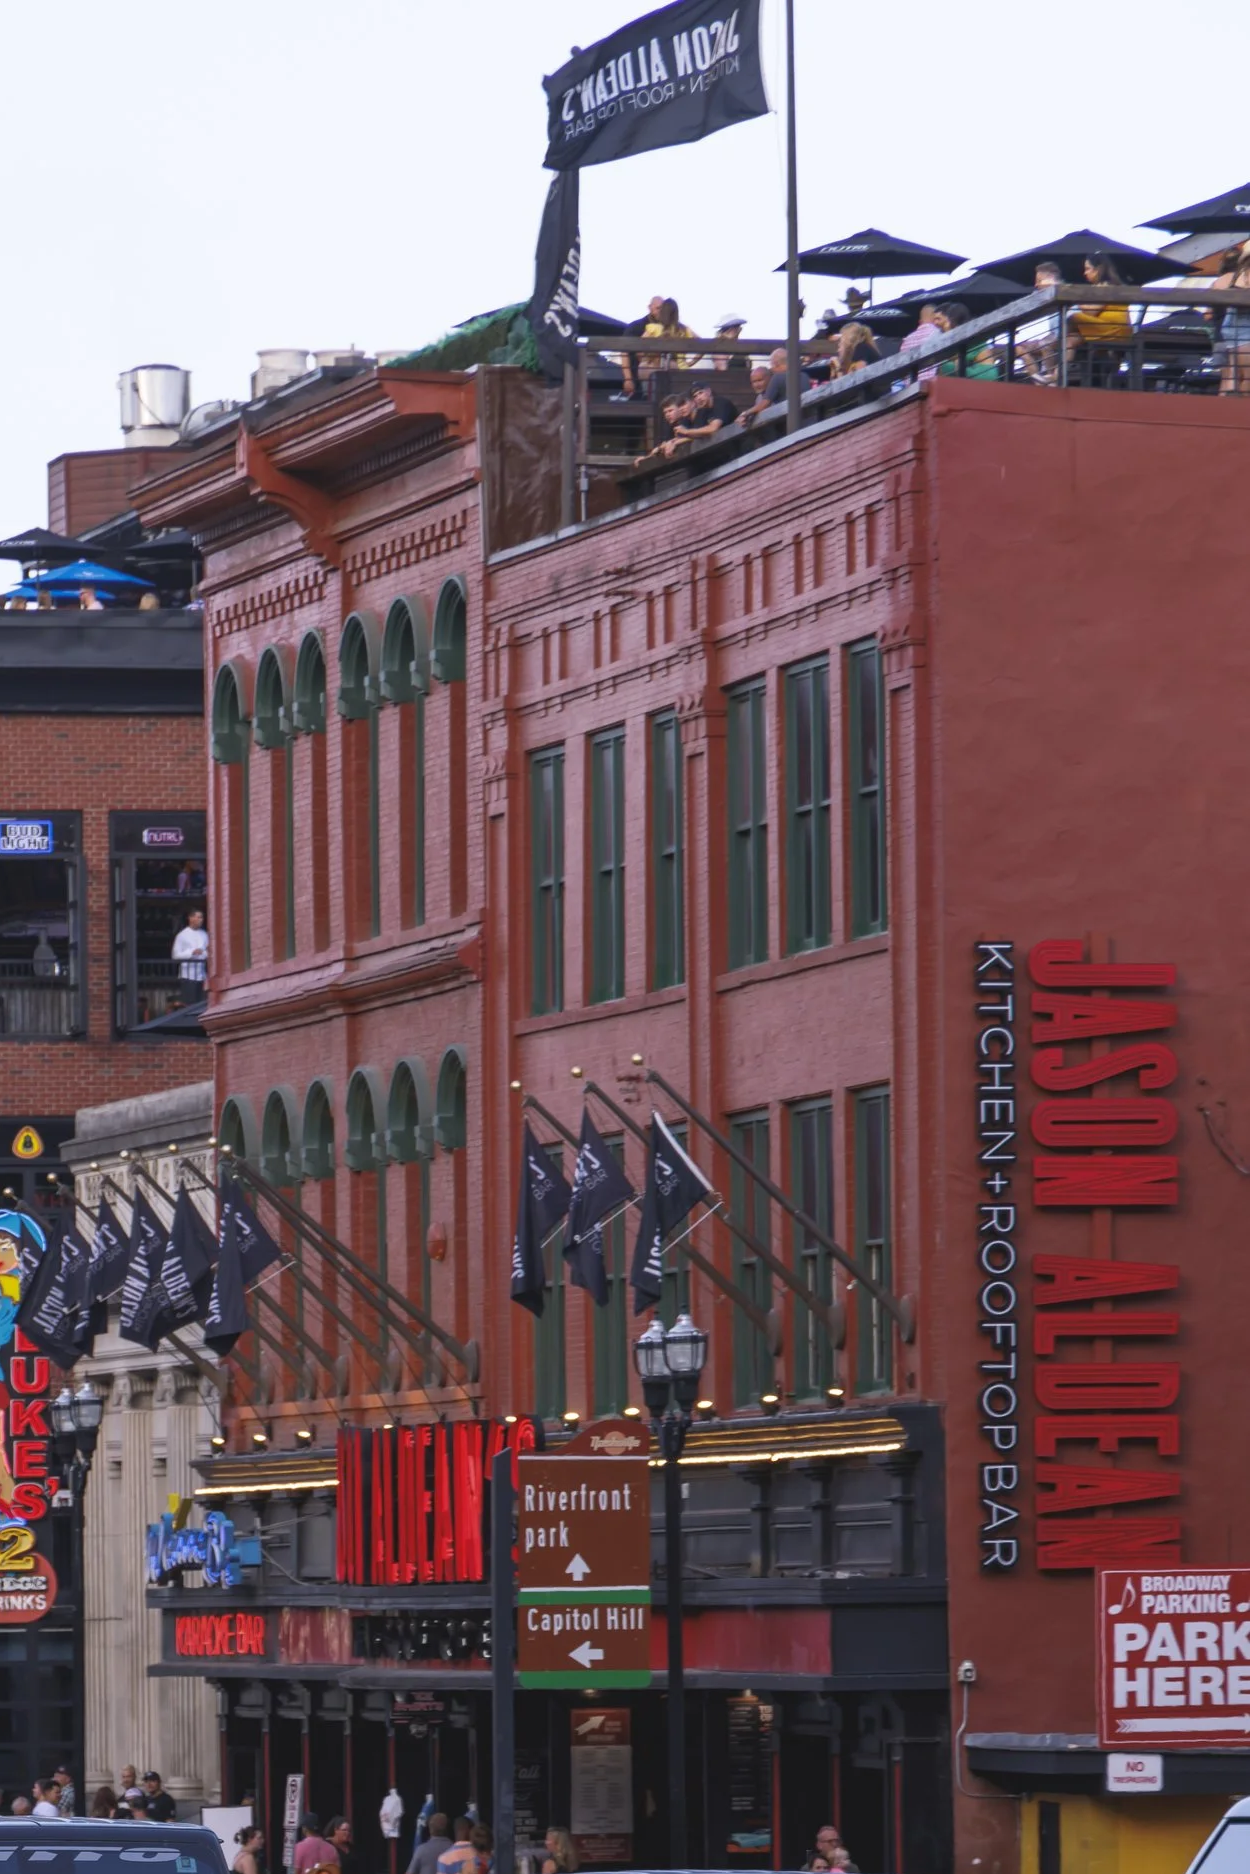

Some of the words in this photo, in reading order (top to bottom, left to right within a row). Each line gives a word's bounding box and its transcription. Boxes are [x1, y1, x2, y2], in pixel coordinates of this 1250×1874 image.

[1, 836, 49, 850] LIGHT
[6, 825, 42, 837] BUD
[975, 941, 1015, 1161] KITCHEN
[1029, 938, 1179, 1206] JASON
[33, 1286, 66, 1334] JASON
[979, 1206, 1017, 1450] ROOFTOP
[1032, 1253, 1181, 1570] ALDEAN
[525, 1483, 631, 1512] Riverfront
[981, 1465, 1018, 1568] BAR
[525, 1520, 570, 1553] park
[1141, 1575, 1232, 1592] BROADWAY
[1141, 1593, 1232, 1614] PARKING
[176, 1613, 235, 1656] KARAOKE
[236, 1612, 265, 1656] BAR
[527, 1607, 599, 1635] Capitol
[607, 1607, 643, 1630] Hill
[1113, 1621, 1250, 1663] PARK
[1112, 1664, 1250, 1709] HERE
[1125, 1761, 1145, 1772] NO
